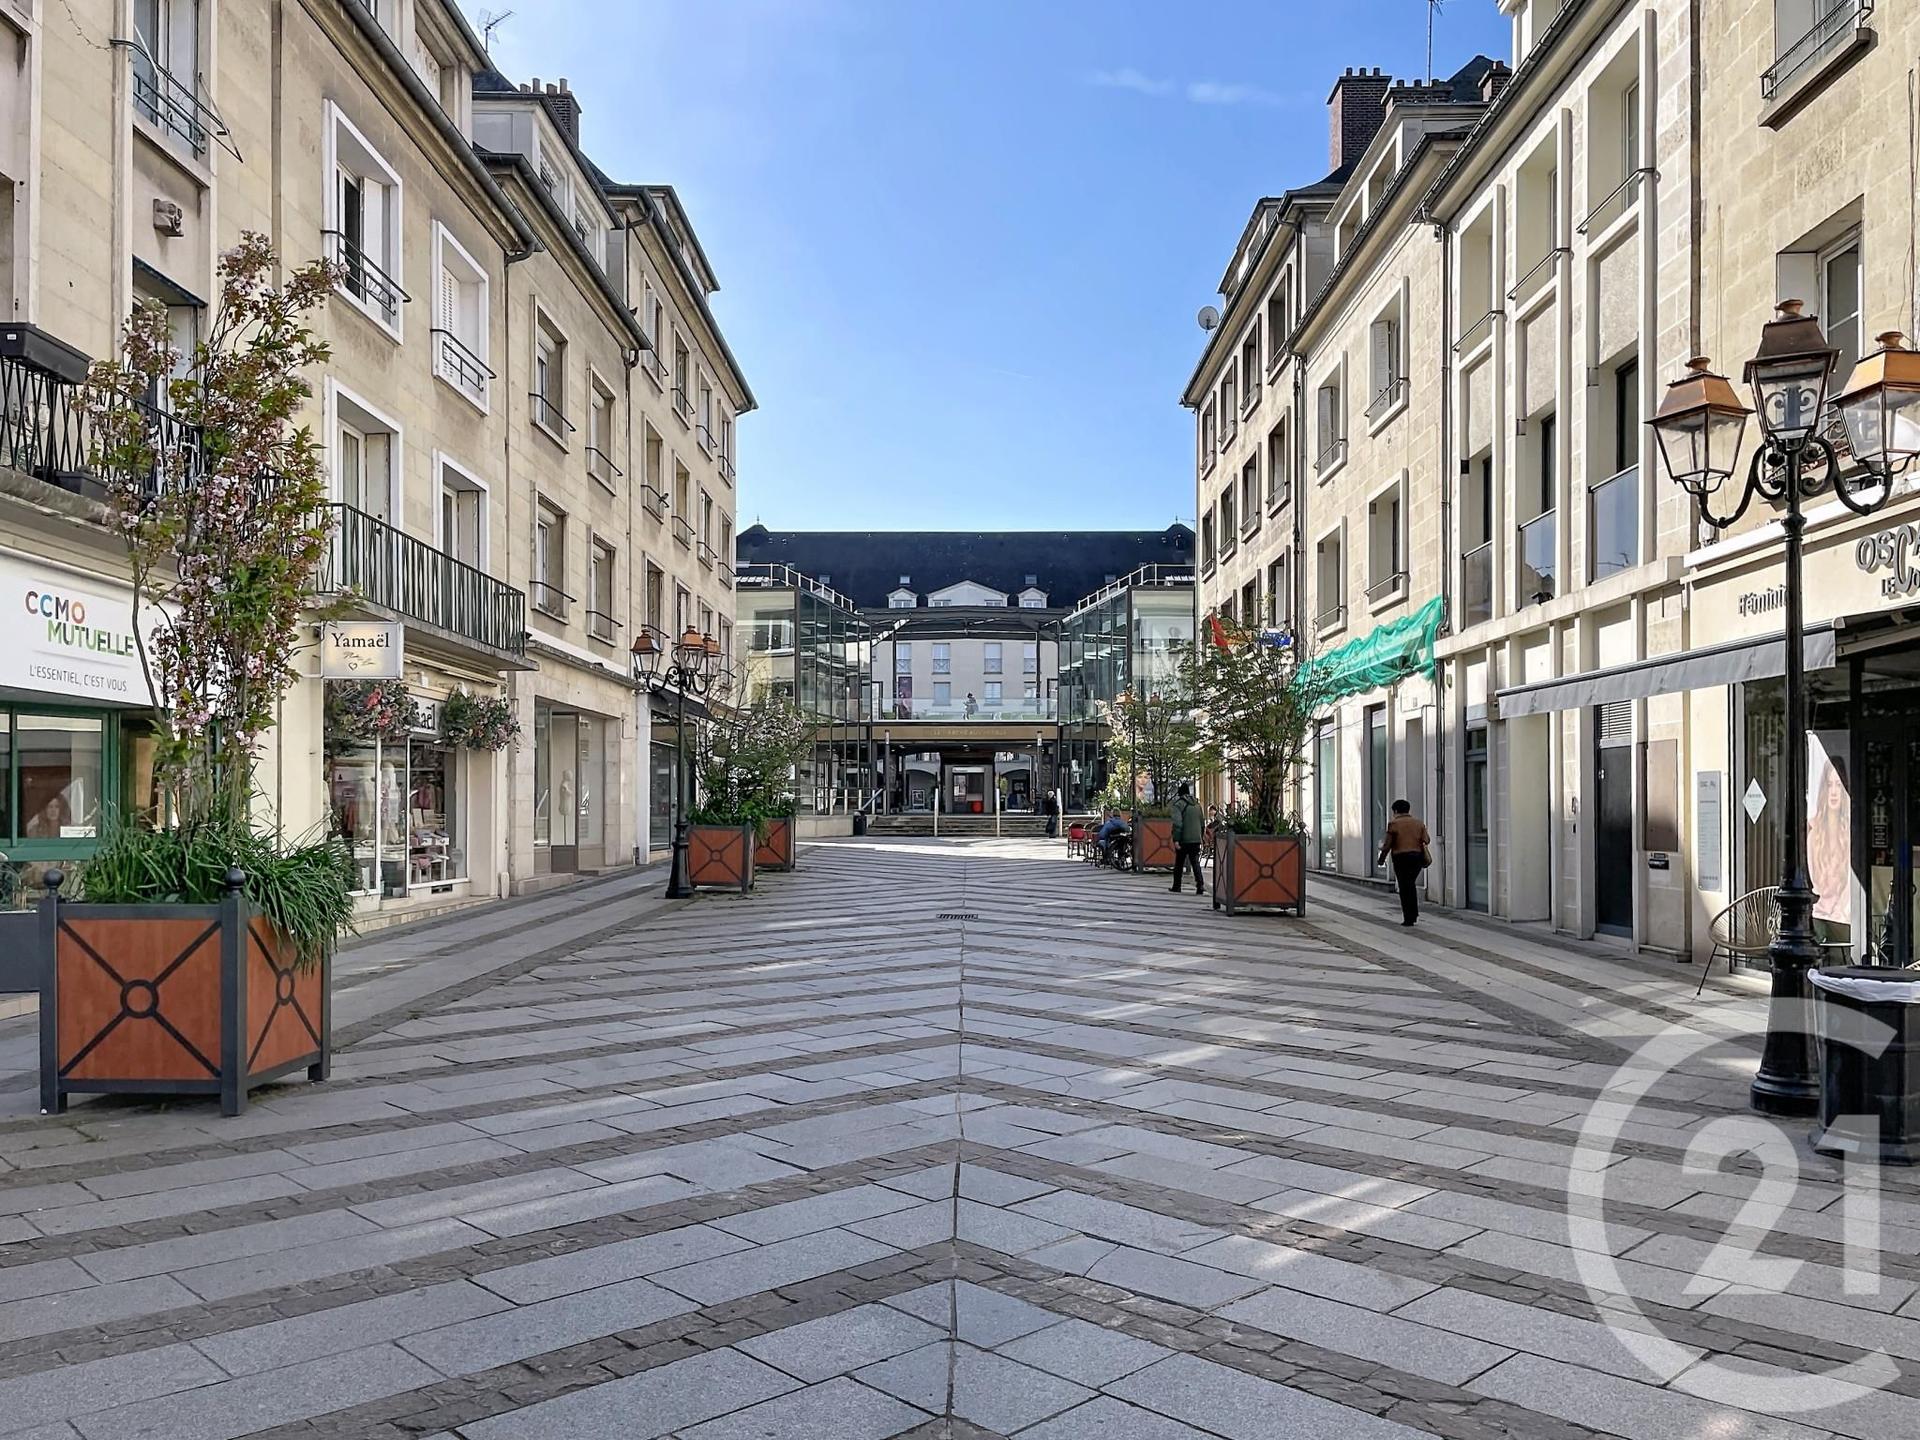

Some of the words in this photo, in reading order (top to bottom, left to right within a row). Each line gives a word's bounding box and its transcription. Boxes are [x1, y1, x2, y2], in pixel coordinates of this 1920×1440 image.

[25, 591, 85, 624] CCMO
[48, 620, 134, 657] MUTUELLE
[331, 632, 390, 647] Yamaël
[29, 664, 82, 686] L'ESSENTIEL,
[84, 674, 104, 688] C'EST
[107, 679, 127, 692] VOUS
